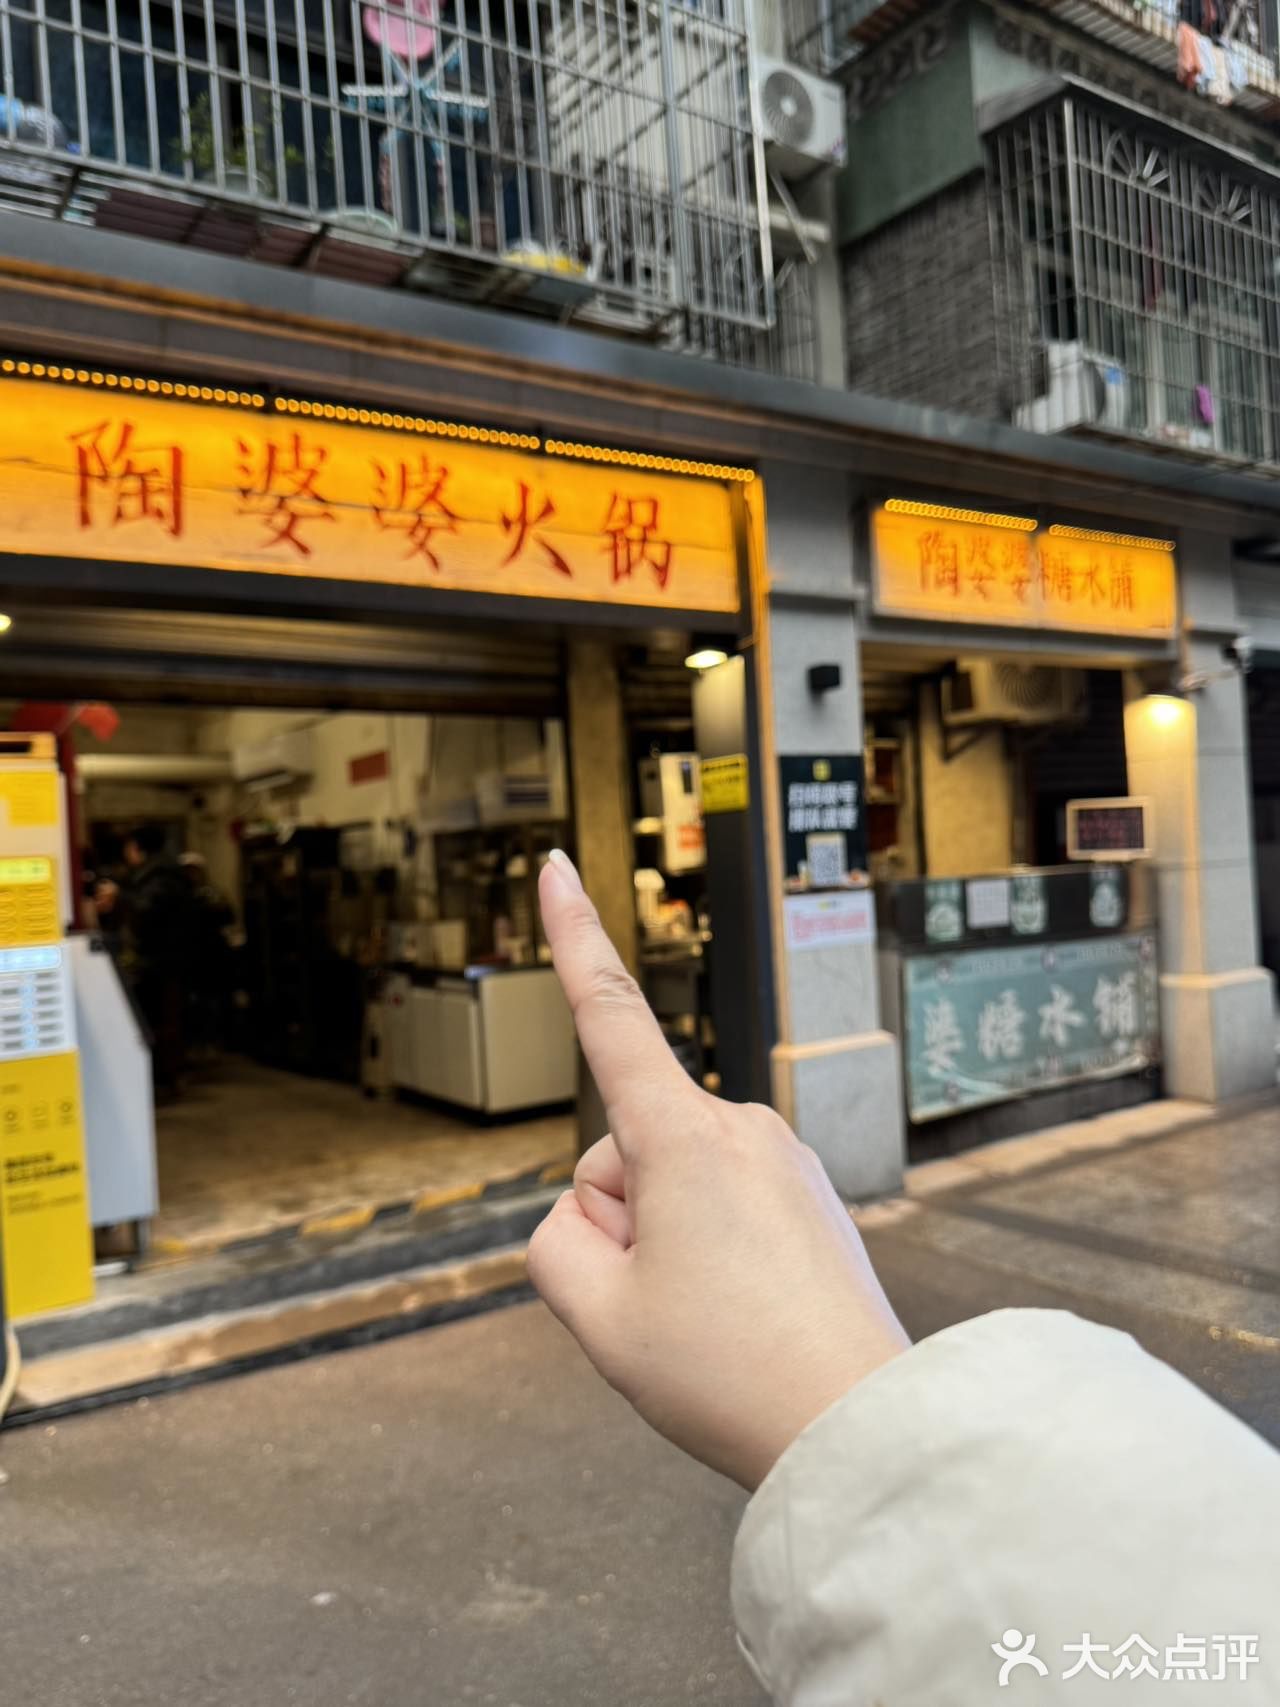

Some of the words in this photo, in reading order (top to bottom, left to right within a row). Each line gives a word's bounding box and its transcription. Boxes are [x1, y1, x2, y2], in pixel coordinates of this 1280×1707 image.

[68, 420, 673, 589] 陶婆婆火锅
